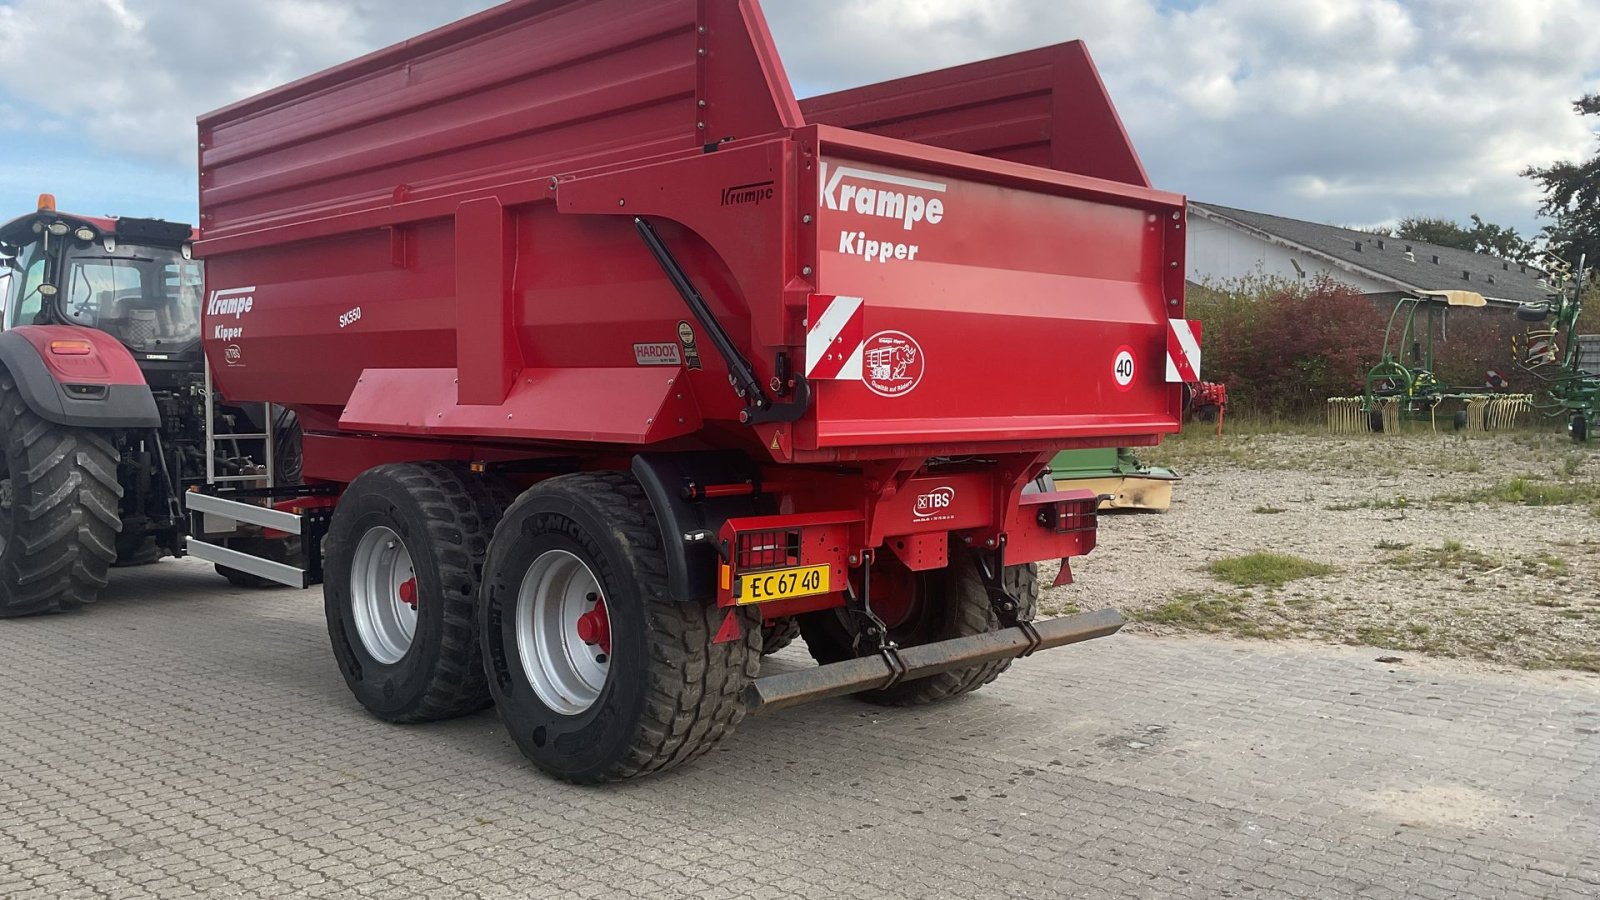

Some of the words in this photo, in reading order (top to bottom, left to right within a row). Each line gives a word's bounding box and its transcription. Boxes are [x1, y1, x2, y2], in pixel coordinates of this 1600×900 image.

[720, 180, 774, 206] Krampe
[819, 162, 947, 230] Krampe
[839, 230, 918, 264] Kipper
[207, 286, 256, 319] Krampe
[339, 307, 362, 329] SK550
[215, 324, 243, 341] Kipper
[635, 345, 676, 358] HARDOX
[1116, 359, 1131, 377] 40
[753, 576, 774, 598] EC
[778, 573, 797, 594] 67
[802, 570, 819, 591] 40
